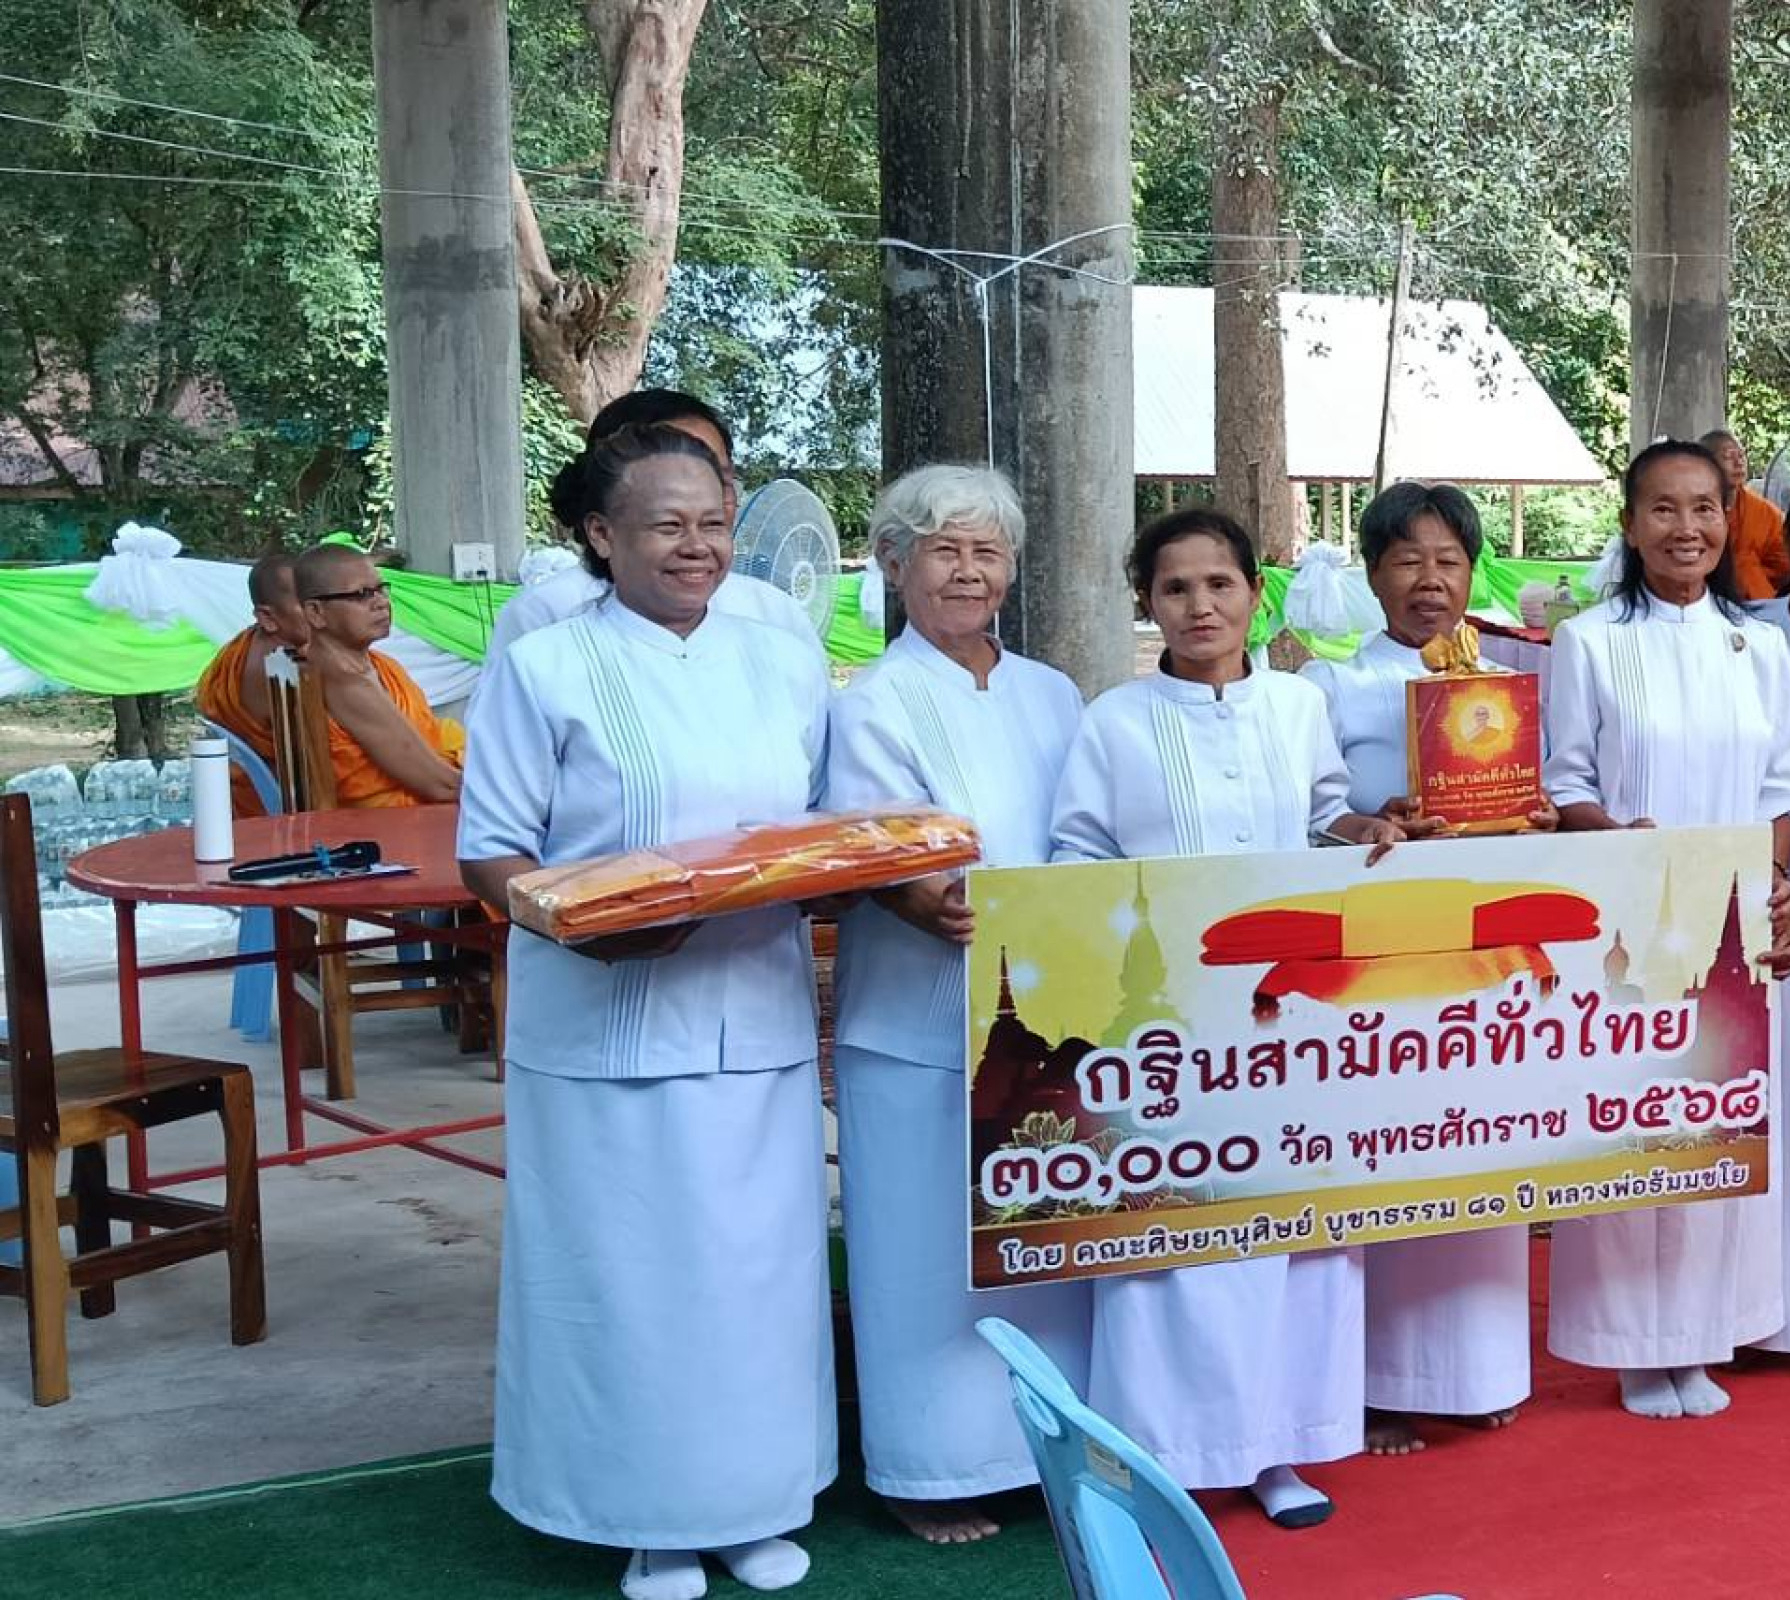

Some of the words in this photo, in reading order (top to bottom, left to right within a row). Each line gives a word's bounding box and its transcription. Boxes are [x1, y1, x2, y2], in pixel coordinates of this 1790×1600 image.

[1086, 980, 1690, 1120] กฐินสามัคคีทั่วไทย
[991, 1135, 1260, 1198] ๓๐,๐๐๐
[1279, 1123, 1333, 1165] วัด
[1347, 1107, 1568, 1171] พุทธศักราช
[1587, 1079, 1762, 1133] ๒๕๖๘
[1002, 1241, 1062, 1271] โดย
[1075, 1206, 1313, 1264] คณะศิษยานุศิษย์
[1325, 1200, 1456, 1242] บูชาธรรม
[1467, 1195, 1506, 1216] ๘๑
[1516, 1184, 1535, 1209] ปี
[1547, 1160, 1747, 1206] หลวงพ่อธัมมชโย
